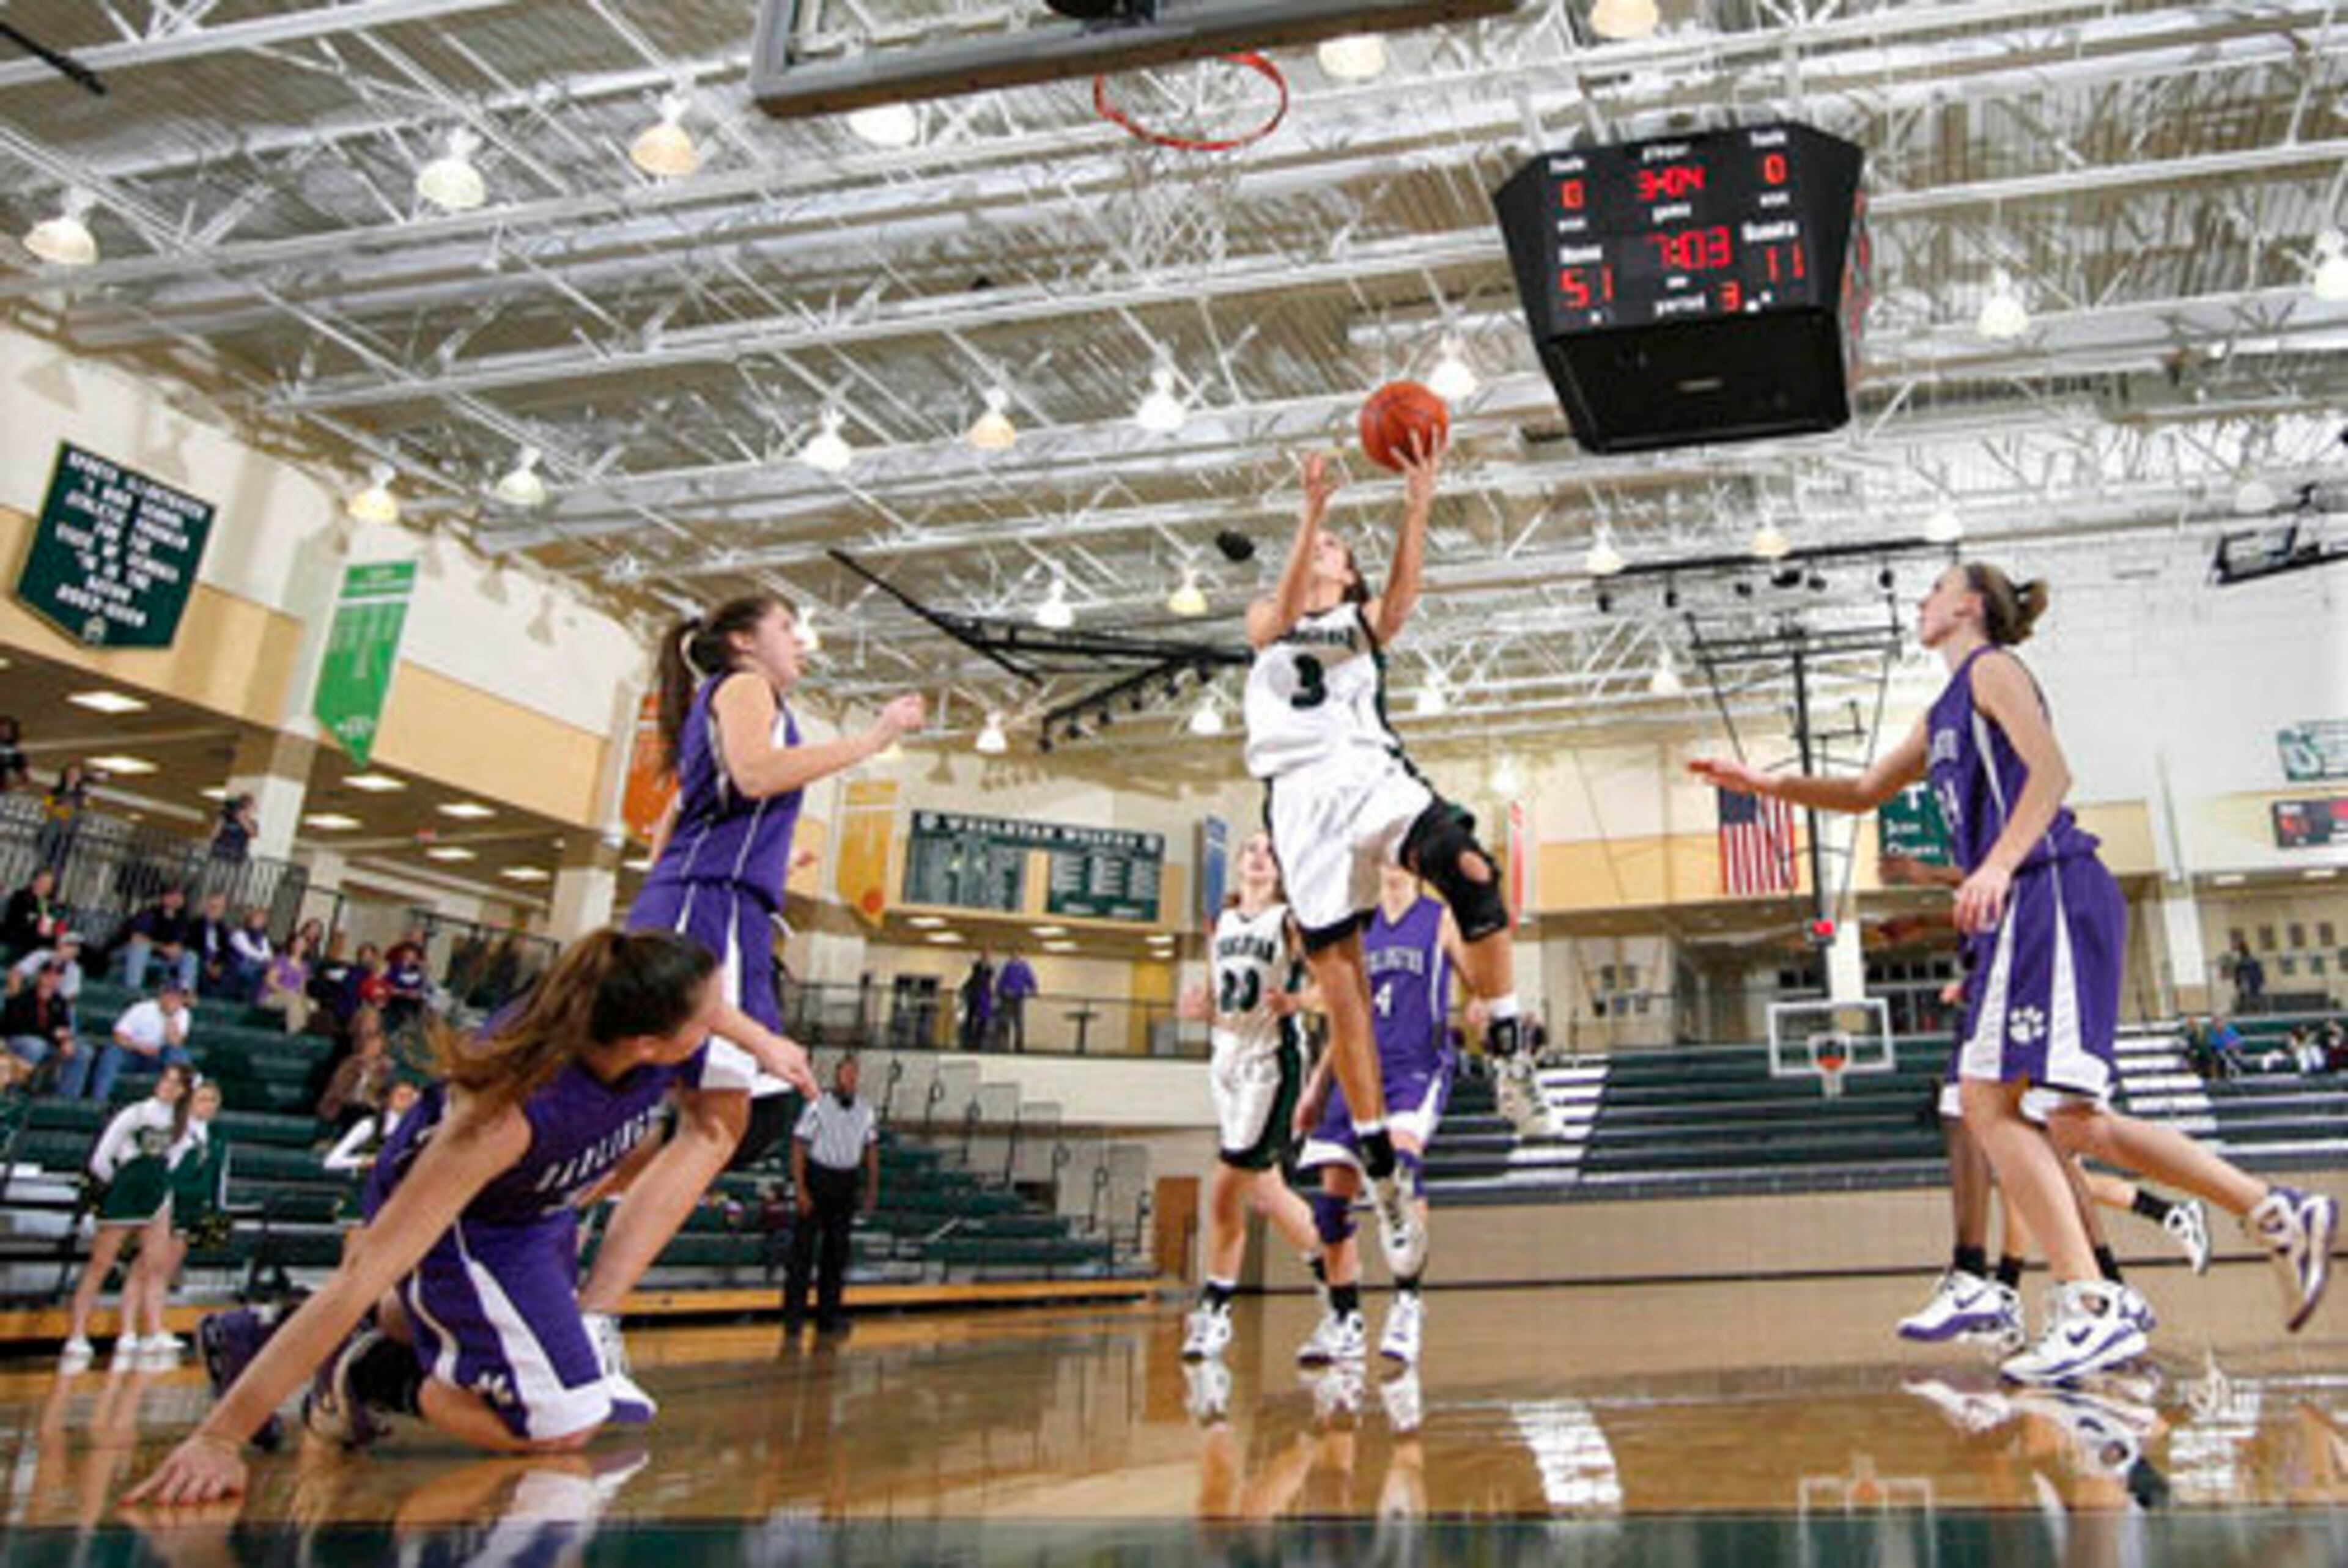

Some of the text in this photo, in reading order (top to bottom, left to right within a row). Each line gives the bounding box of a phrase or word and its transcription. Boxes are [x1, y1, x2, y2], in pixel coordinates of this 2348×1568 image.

[1765, 154, 1785, 185] 0
[1646, 226, 1732, 270] 7:03
[1559, 263, 1614, 308] 51
[1719, 280, 1741, 312] 3
[1291, 654, 1327, 709] 3
[1374, 982, 1392, 1018] 4
